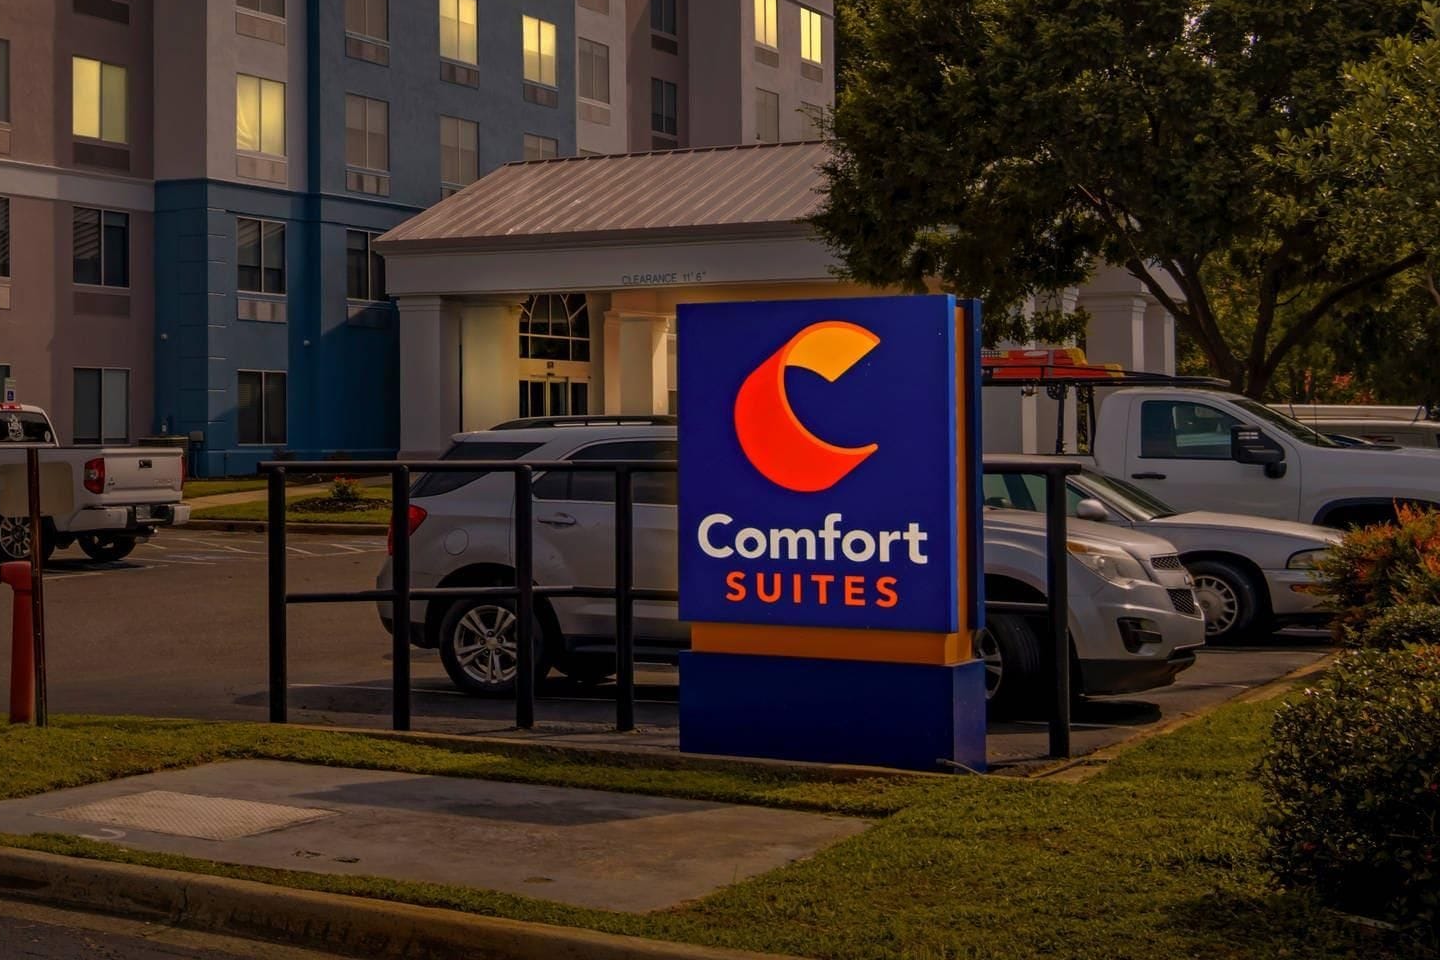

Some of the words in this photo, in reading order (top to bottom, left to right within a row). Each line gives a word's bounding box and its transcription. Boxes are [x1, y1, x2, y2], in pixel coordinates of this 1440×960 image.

[622, 272, 677, 285] CLEARANCE
[697, 512, 929, 565] Comfort
[725, 571, 899, 608] SUITES
